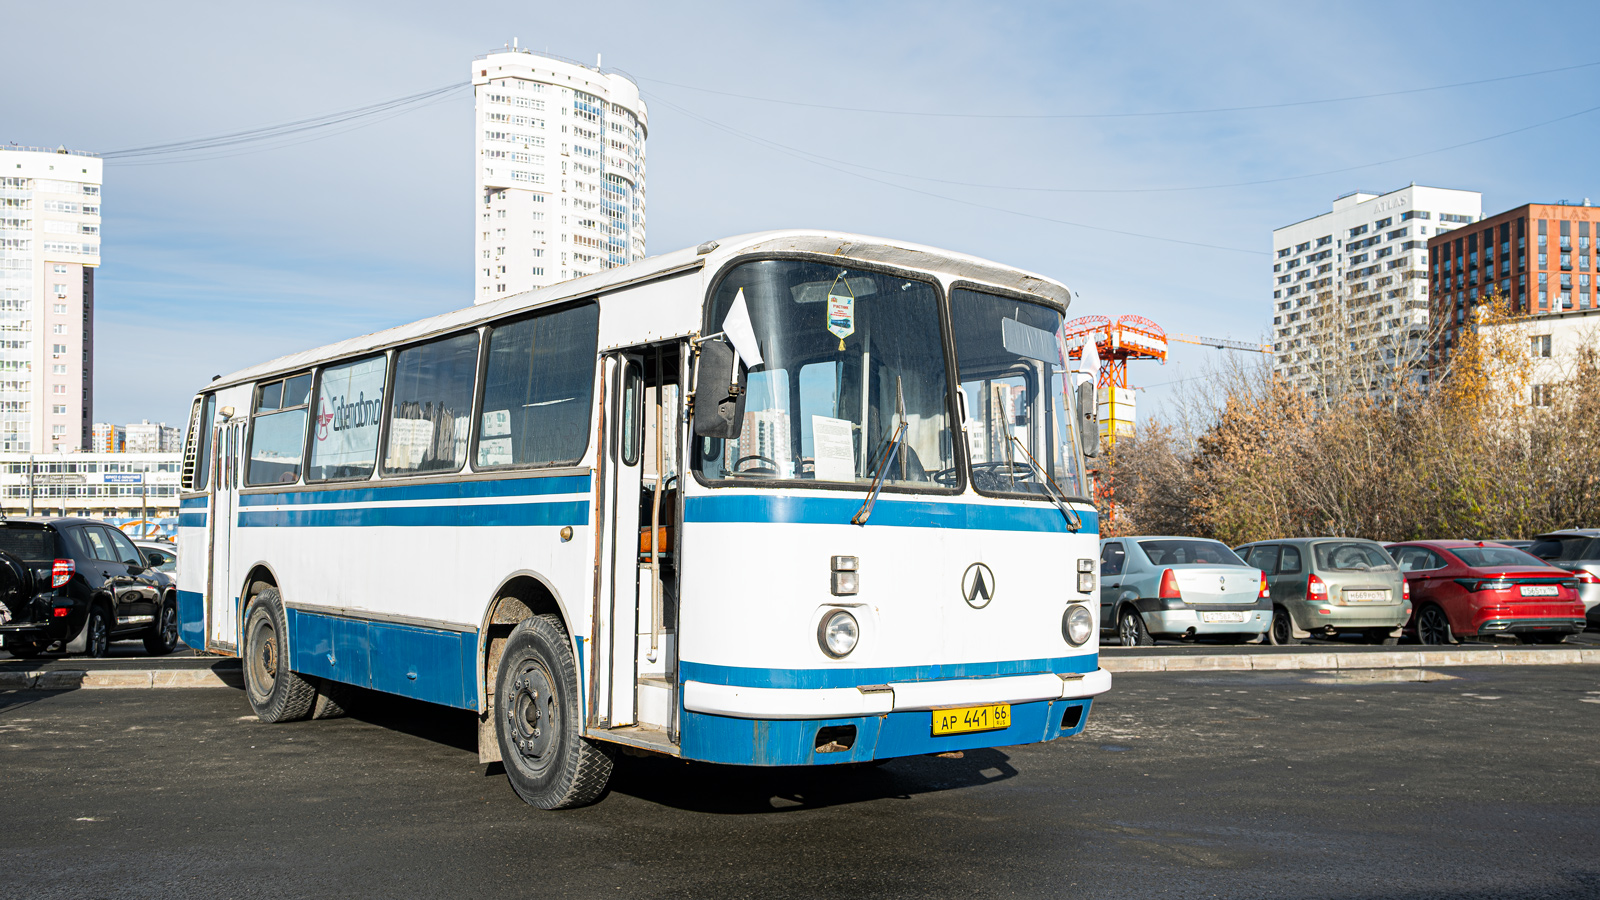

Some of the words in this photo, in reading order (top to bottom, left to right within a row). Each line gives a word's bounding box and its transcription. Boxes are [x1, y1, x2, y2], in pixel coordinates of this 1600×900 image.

[1373, 194, 1408, 215] ATLAS
[1539, 205, 1590, 220] ATLAS
[941, 715, 957, 730] АР
[964, 709, 987, 727] 441
[994, 706, 1007, 719] 66
